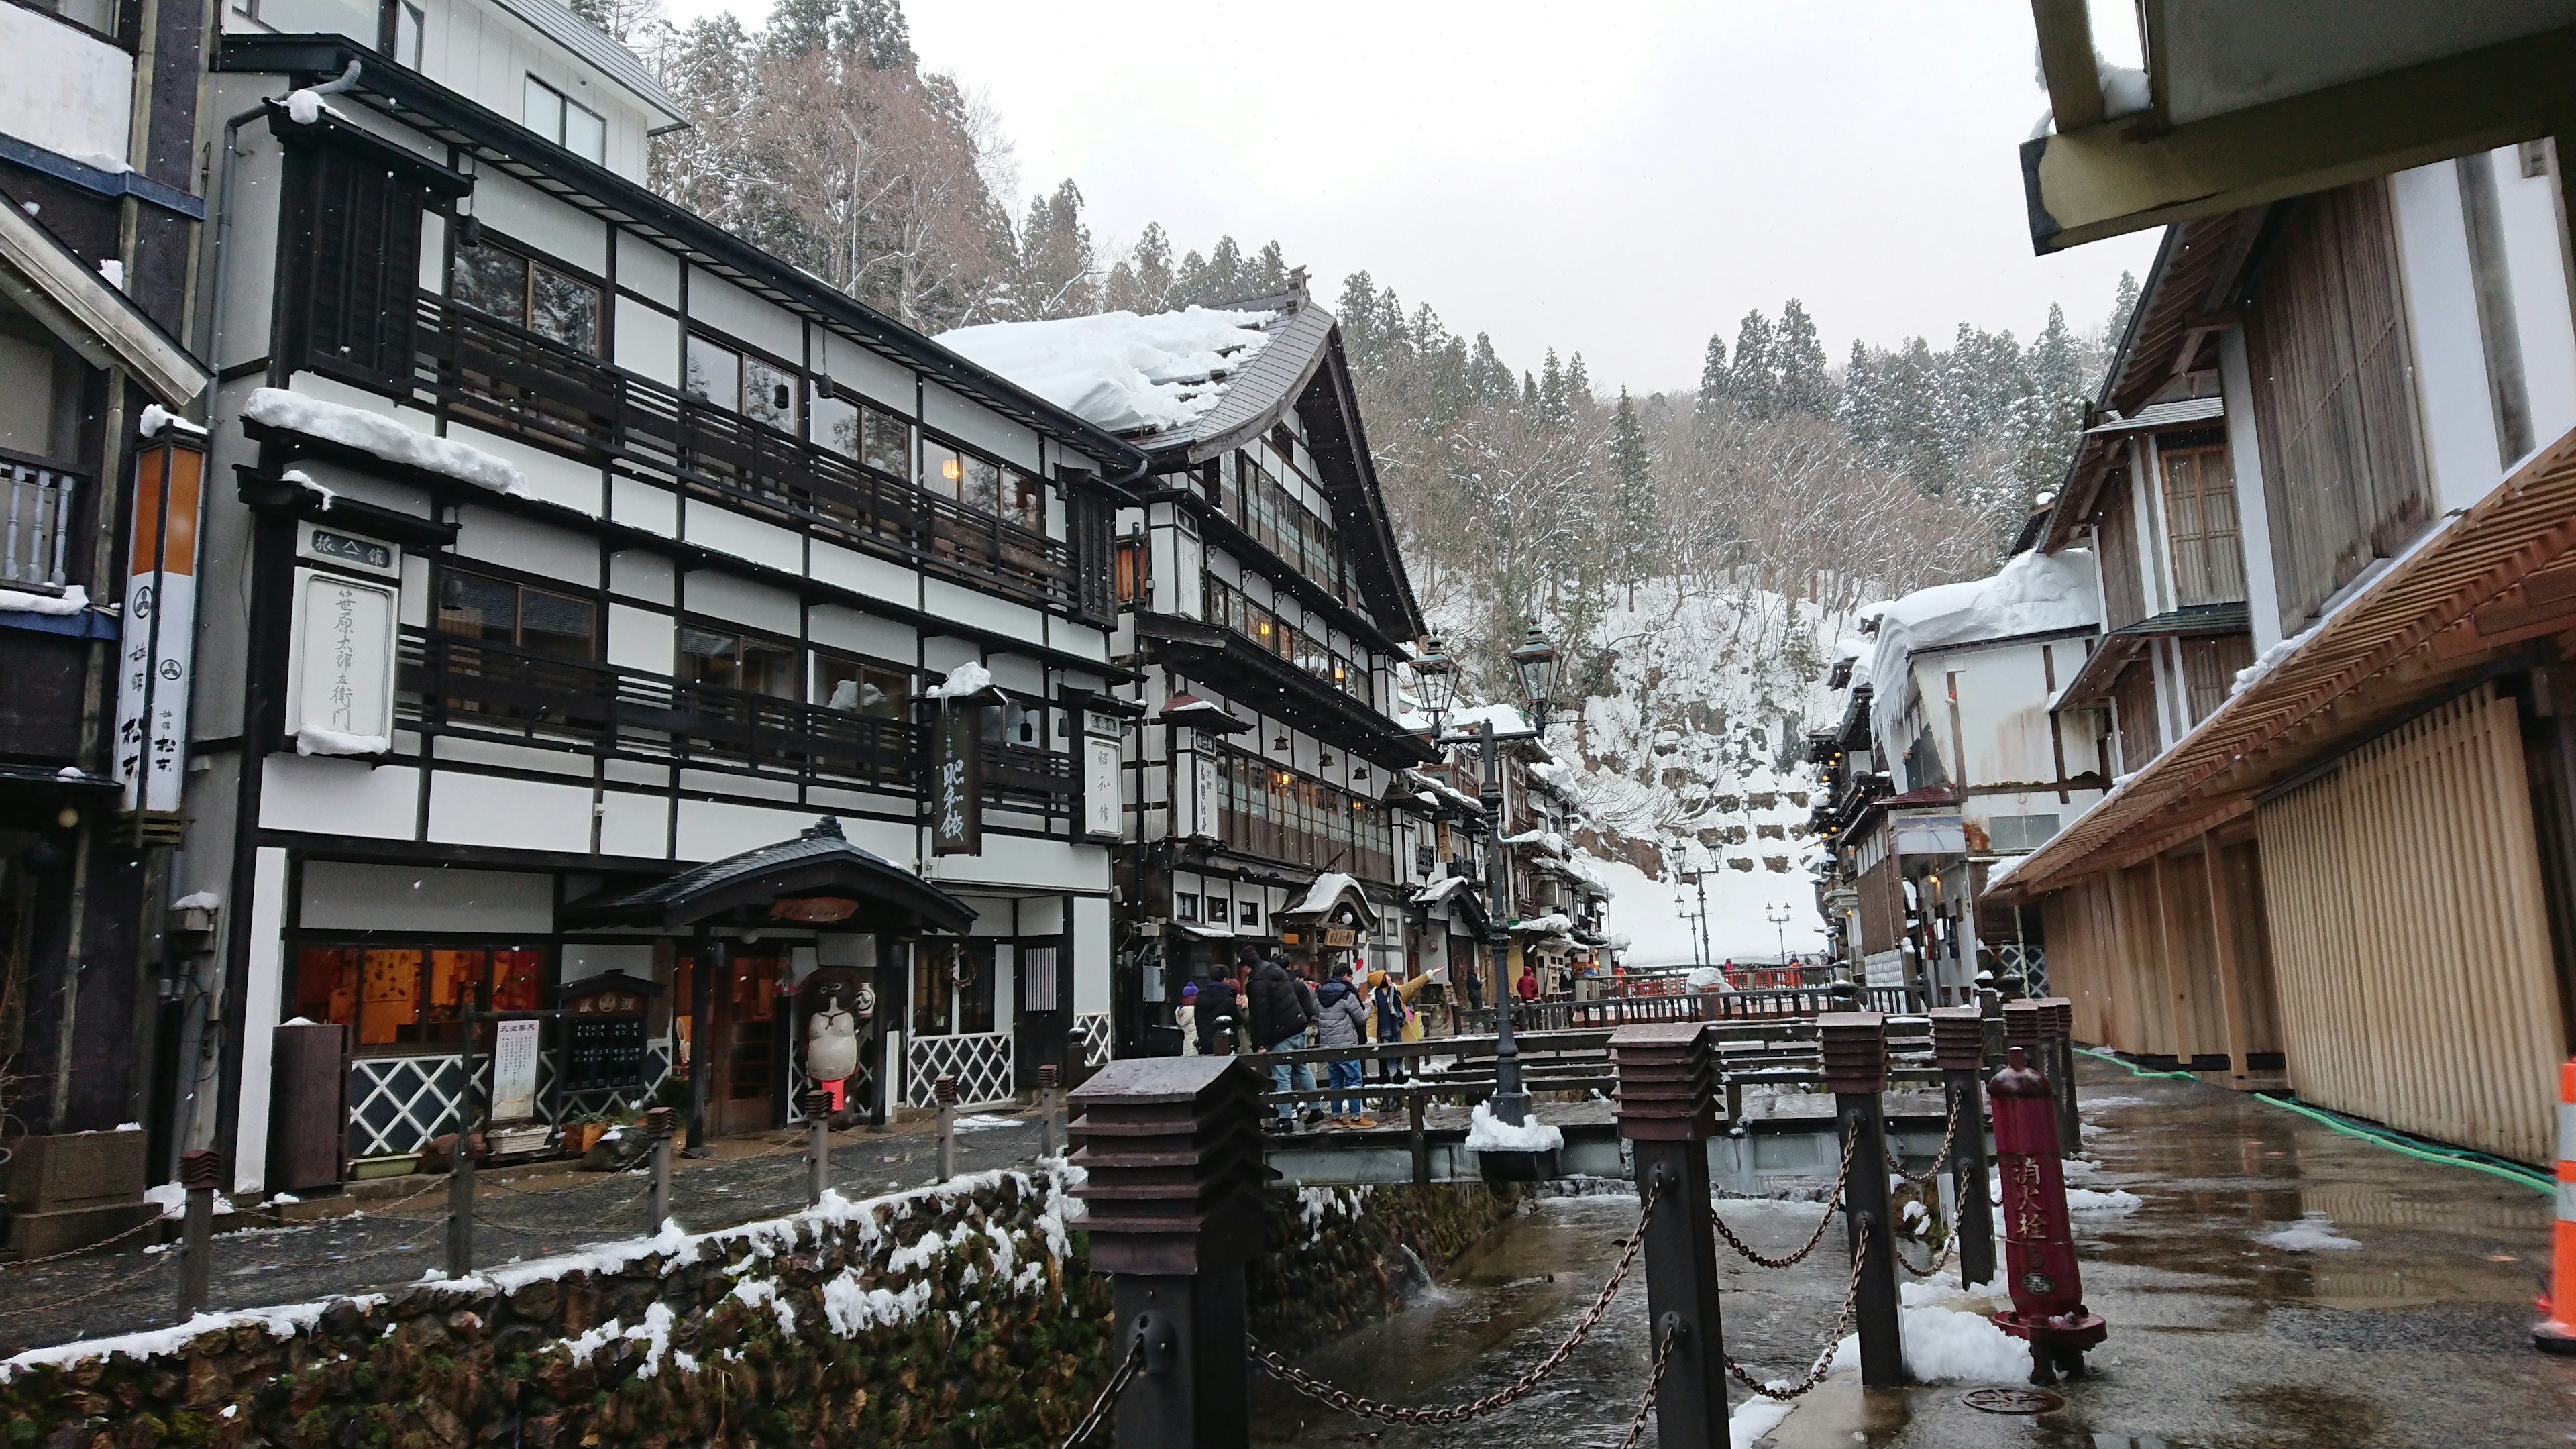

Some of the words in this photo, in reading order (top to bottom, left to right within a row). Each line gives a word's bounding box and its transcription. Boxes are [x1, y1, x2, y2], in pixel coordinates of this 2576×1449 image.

[315, 534, 335, 553] 旅
[368, 548, 384, 566] 館
[329, 589, 356, 731] 笹原太郎左衛門
[940, 759, 965, 841] 昭和館
[1097, 751, 1110, 823] 昭和館
[2013, 1157, 2049, 1239] 消火栓
